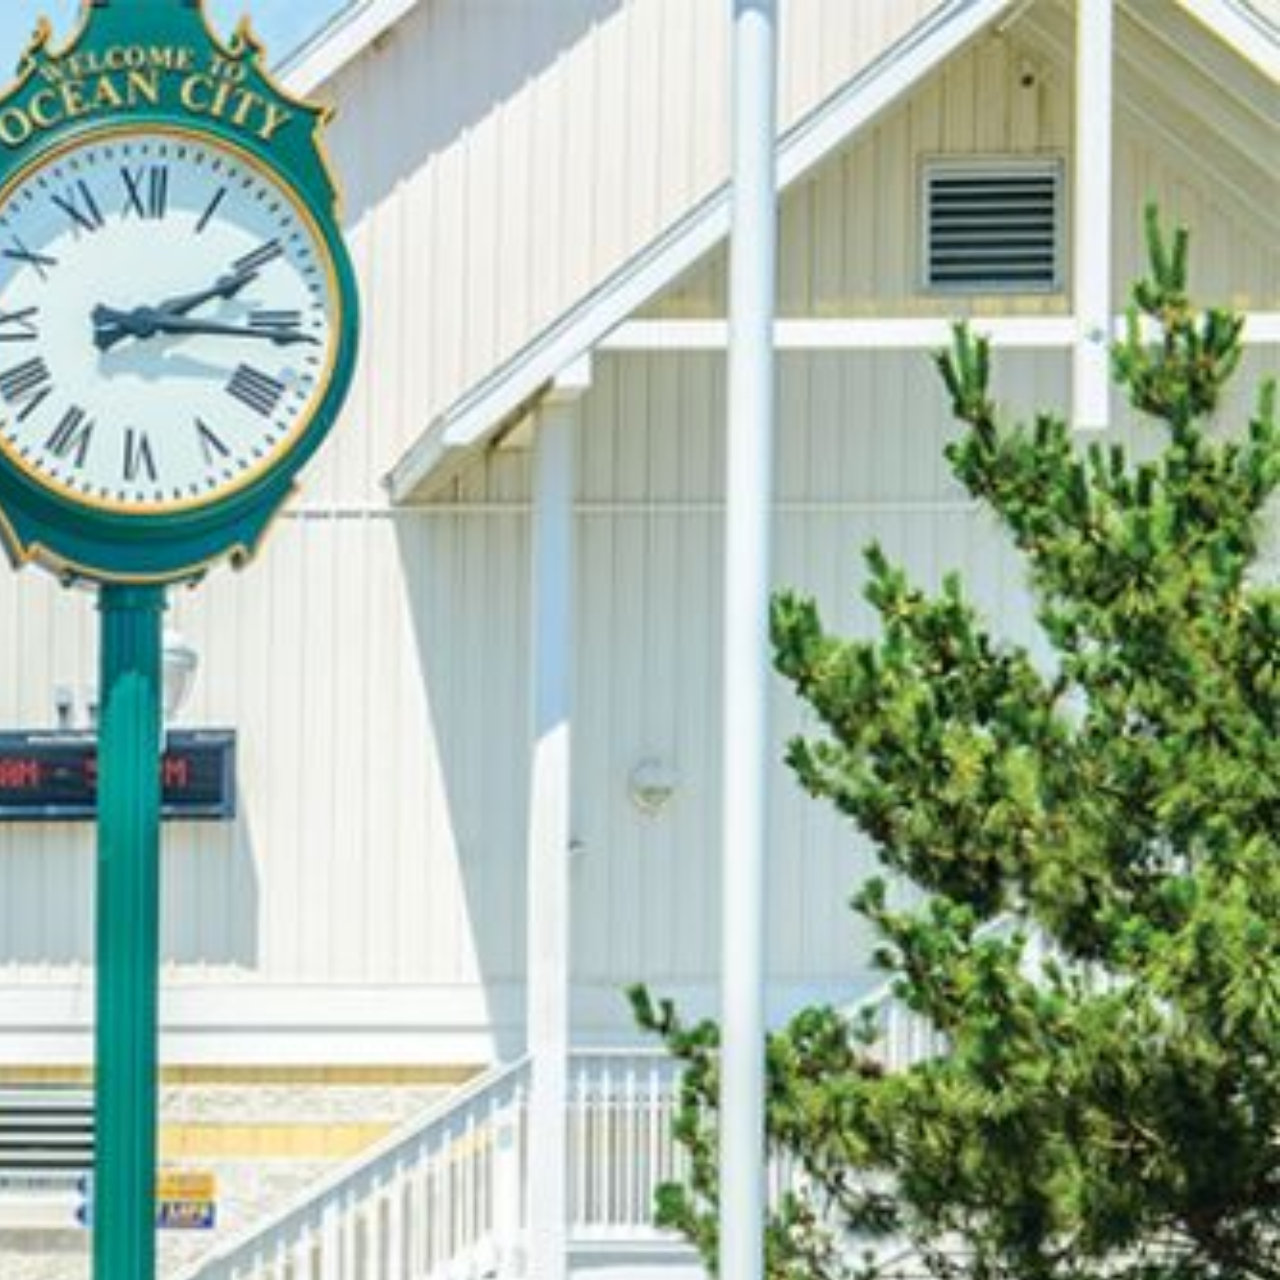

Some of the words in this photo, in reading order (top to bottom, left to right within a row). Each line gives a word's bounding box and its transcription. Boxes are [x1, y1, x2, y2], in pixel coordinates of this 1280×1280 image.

[39, 45, 194, 83] WELCOME
[211, 54, 246, 82] TO
[180, 73, 292, 141] CITY
[120, 165, 169, 220] XII
